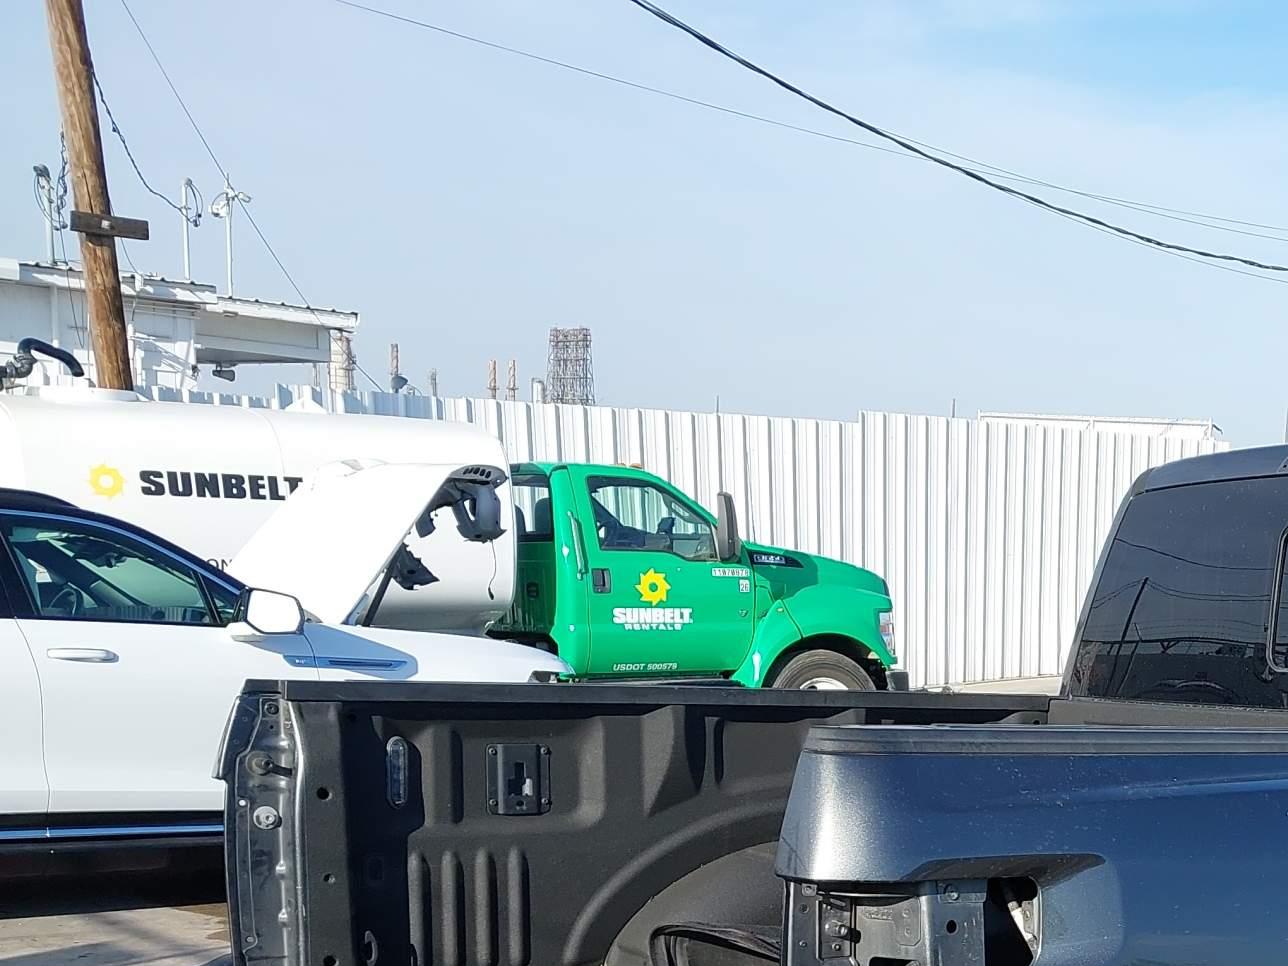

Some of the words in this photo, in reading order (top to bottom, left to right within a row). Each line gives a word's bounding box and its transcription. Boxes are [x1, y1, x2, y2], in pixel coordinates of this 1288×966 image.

[139, 470, 303, 501] SUNBELT
[612, 607, 693, 624] SUNBELT
[624, 623, 683, 631] RENTALS
[613, 663, 645, 671] USDOT
